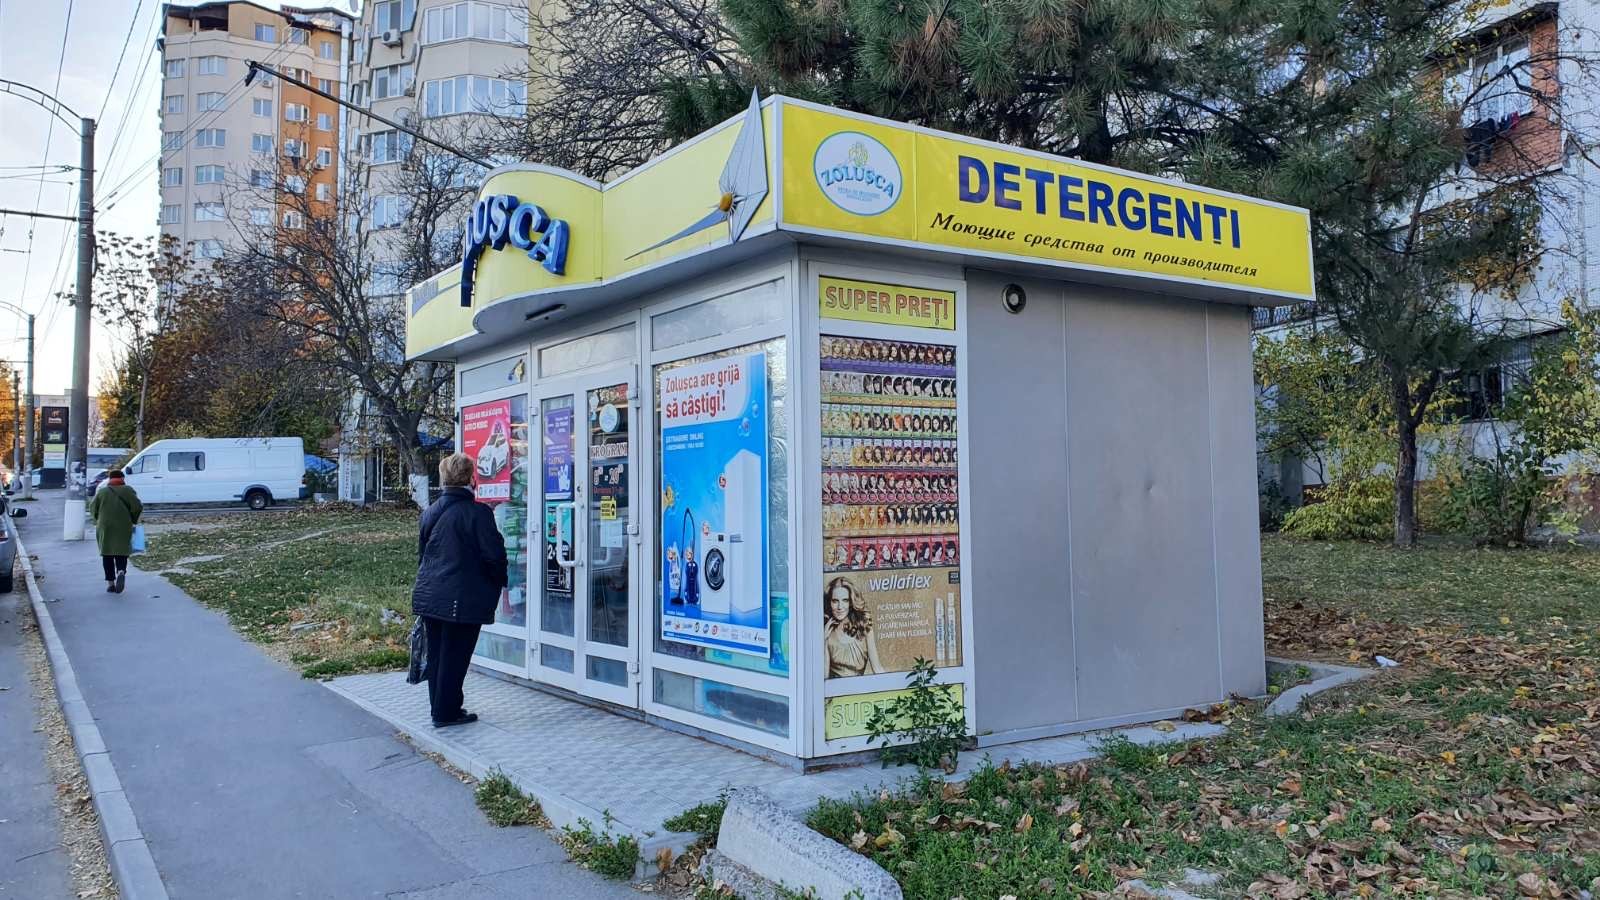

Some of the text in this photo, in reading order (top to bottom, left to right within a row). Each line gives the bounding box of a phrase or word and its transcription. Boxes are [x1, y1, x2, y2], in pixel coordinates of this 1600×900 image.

[958, 155, 1241, 249] DETERGENȚI
[930, 212, 1258, 277] Моющие средства от производителя
[825, 286, 891, 314] SUPER
[700, 372, 716, 386] are
[717, 365, 740, 387] grijă
[666, 390, 726, 420] să câștigi!
[869, 574, 932, 591] wellaflex
